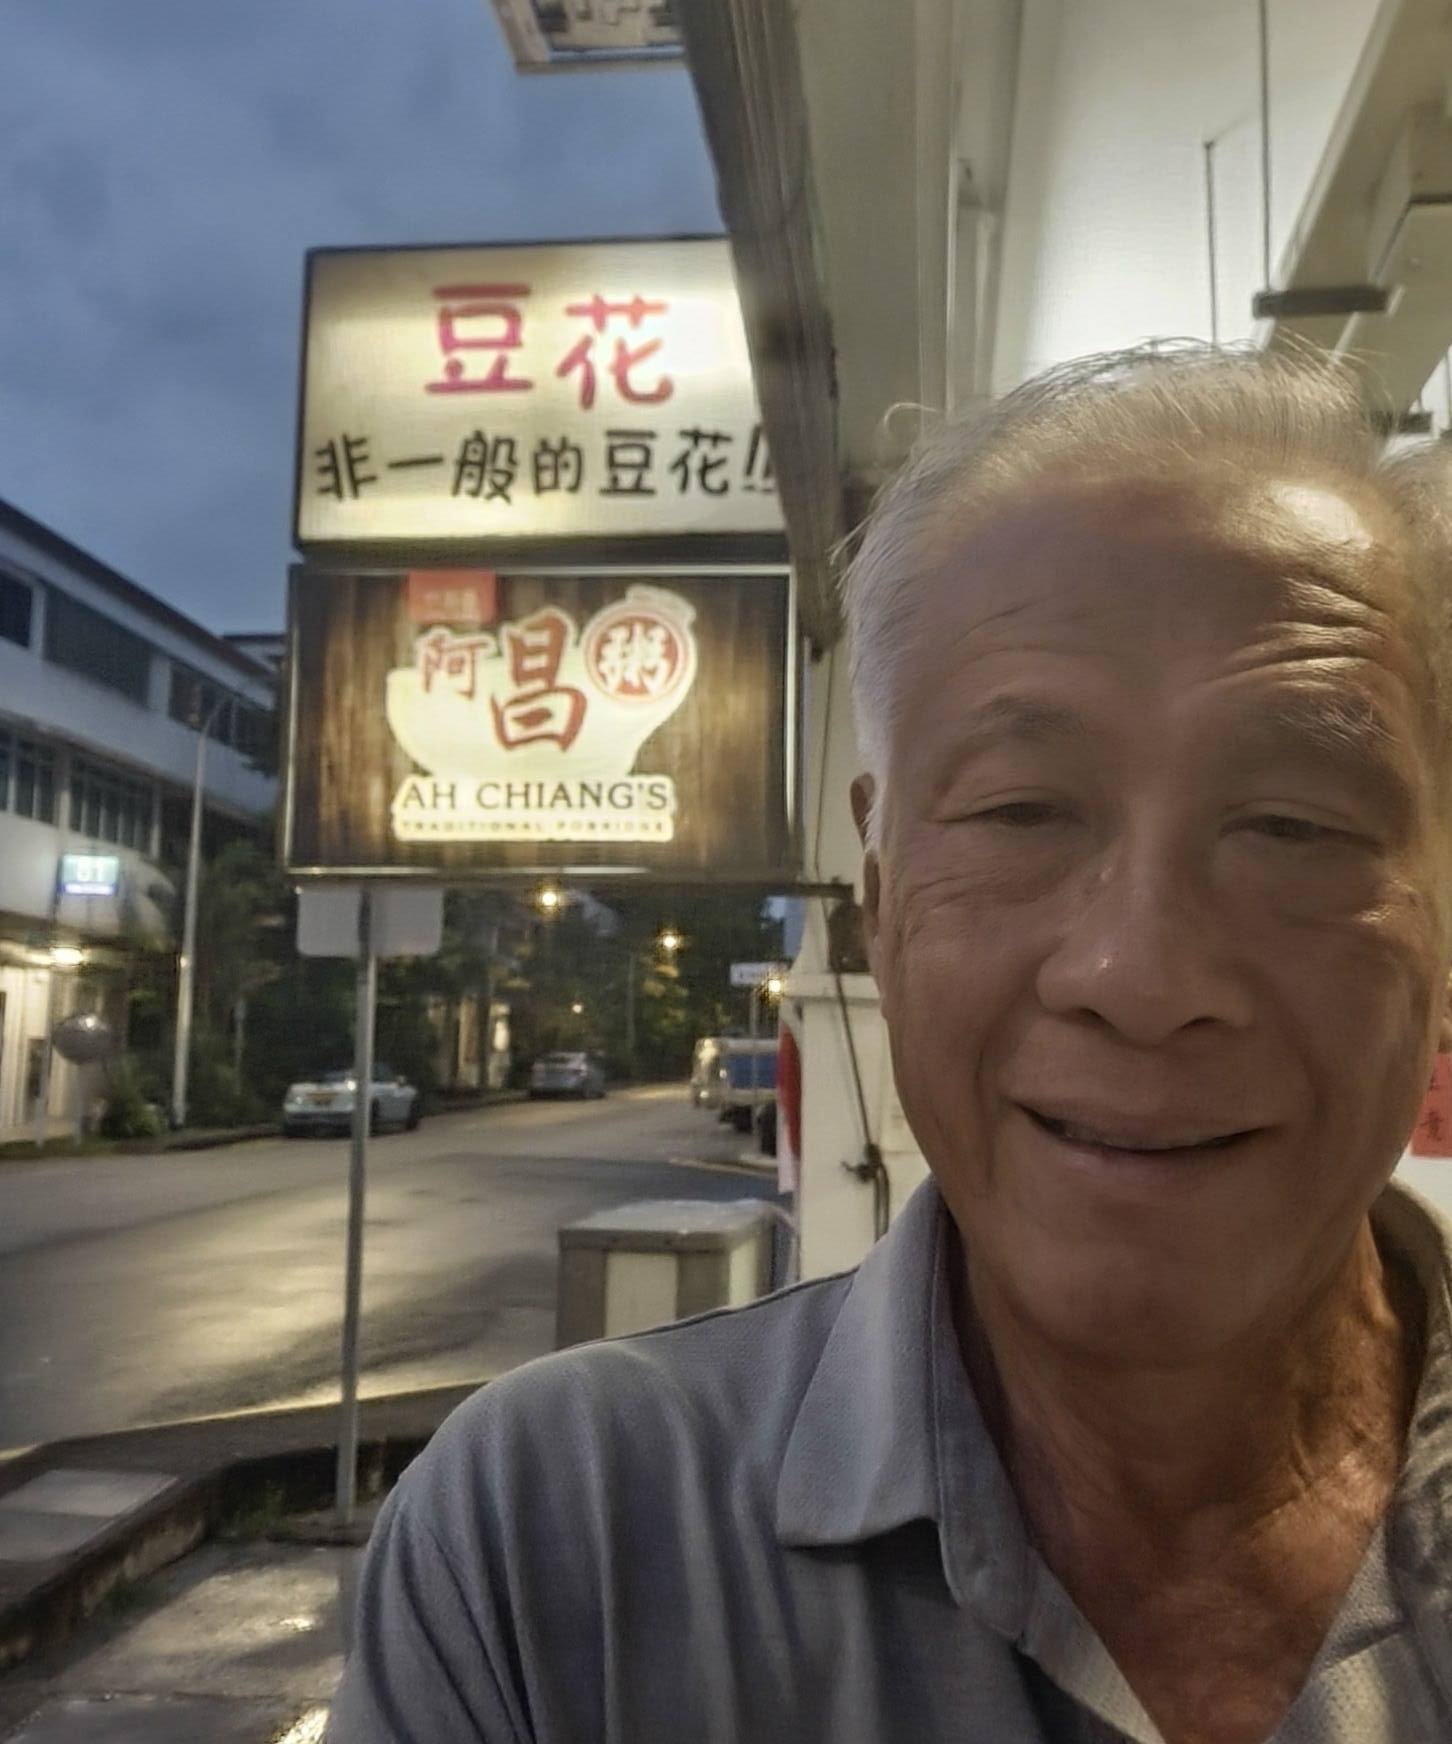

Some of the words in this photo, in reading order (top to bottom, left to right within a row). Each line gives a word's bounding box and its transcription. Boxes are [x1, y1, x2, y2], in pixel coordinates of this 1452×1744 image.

[426, 284, 674, 409] 豆花
[403, 782, 456, 809] AH
[476, 782, 667, 809] CHIANG'S
